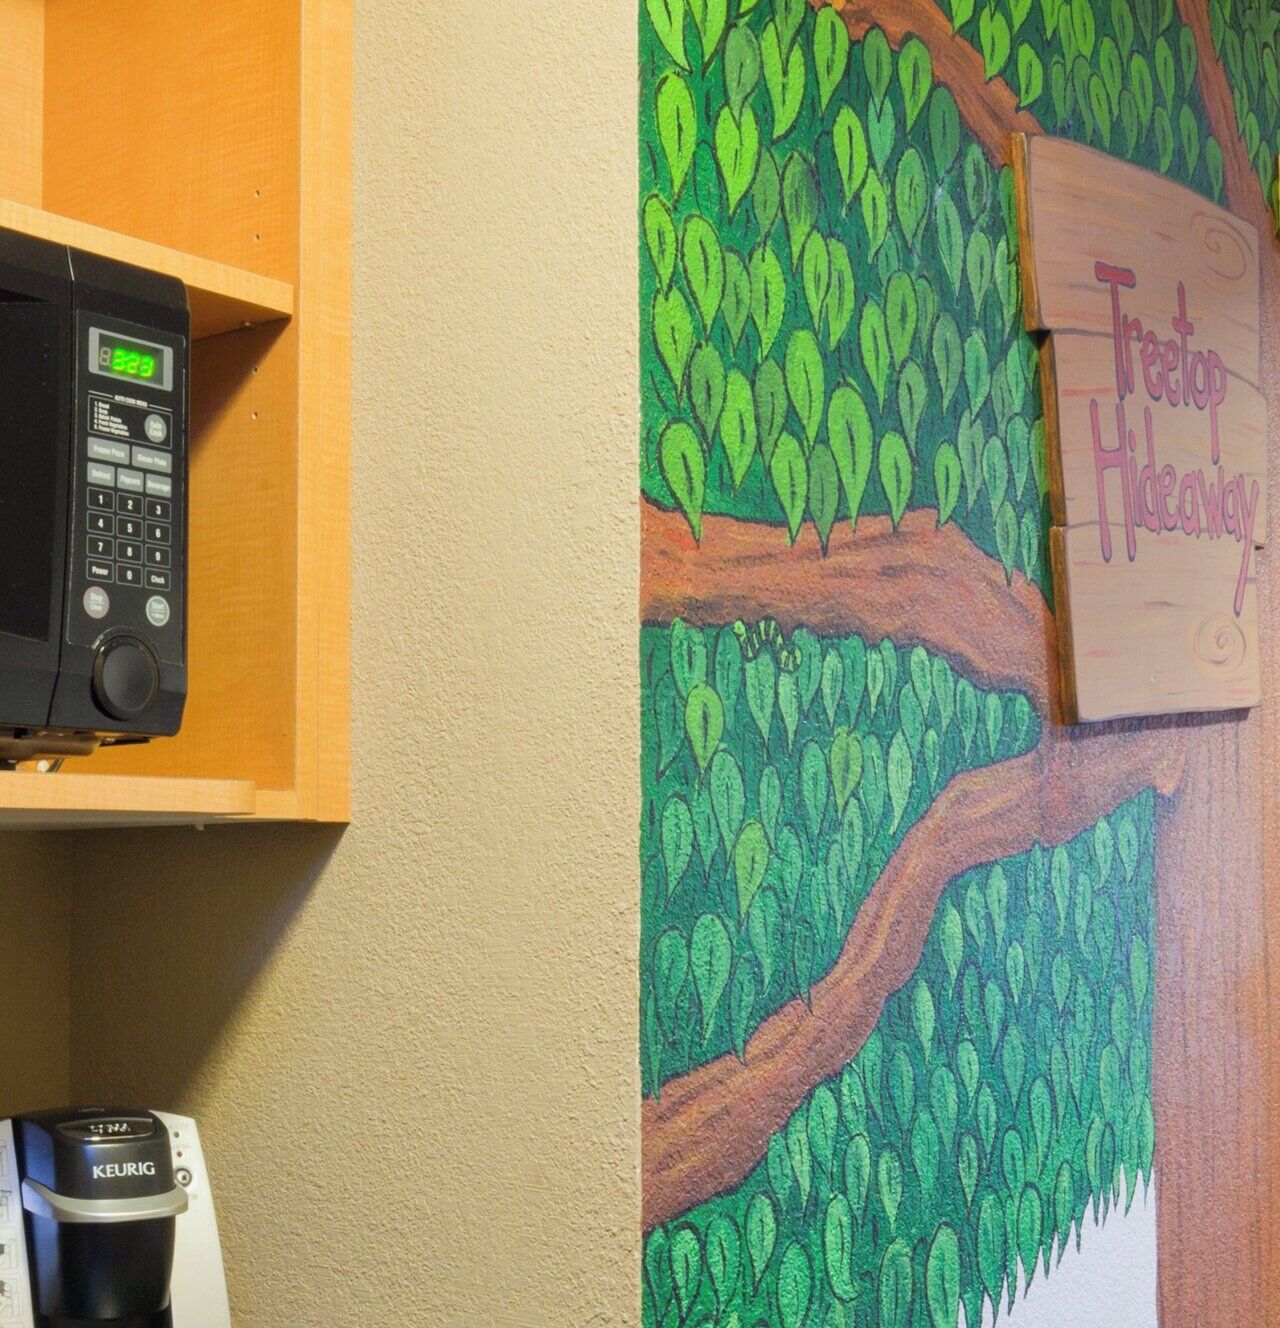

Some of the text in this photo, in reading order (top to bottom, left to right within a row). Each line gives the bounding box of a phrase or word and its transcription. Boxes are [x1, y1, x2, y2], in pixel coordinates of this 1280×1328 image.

[1094, 262, 1227, 465] Treetop
[98, 494, 103, 504] 1
[127, 500, 133, 510] 2
[155, 505, 161, 515] 3
[1090, 398, 1259, 617] Hideaway
[98, 518, 104, 528] 4
[127, 523, 133, 533] 5
[155, 528, 161, 538] 6
[98, 542, 103, 552] 7
[127, 546, 133, 557] 8
[155, 551, 161, 562] 9
[91, 565, 109, 576] Power
[126, 570, 132, 580] 0
[150, 574, 165, 585] Clock
[92, 1162, 156, 1179] KEURIG
